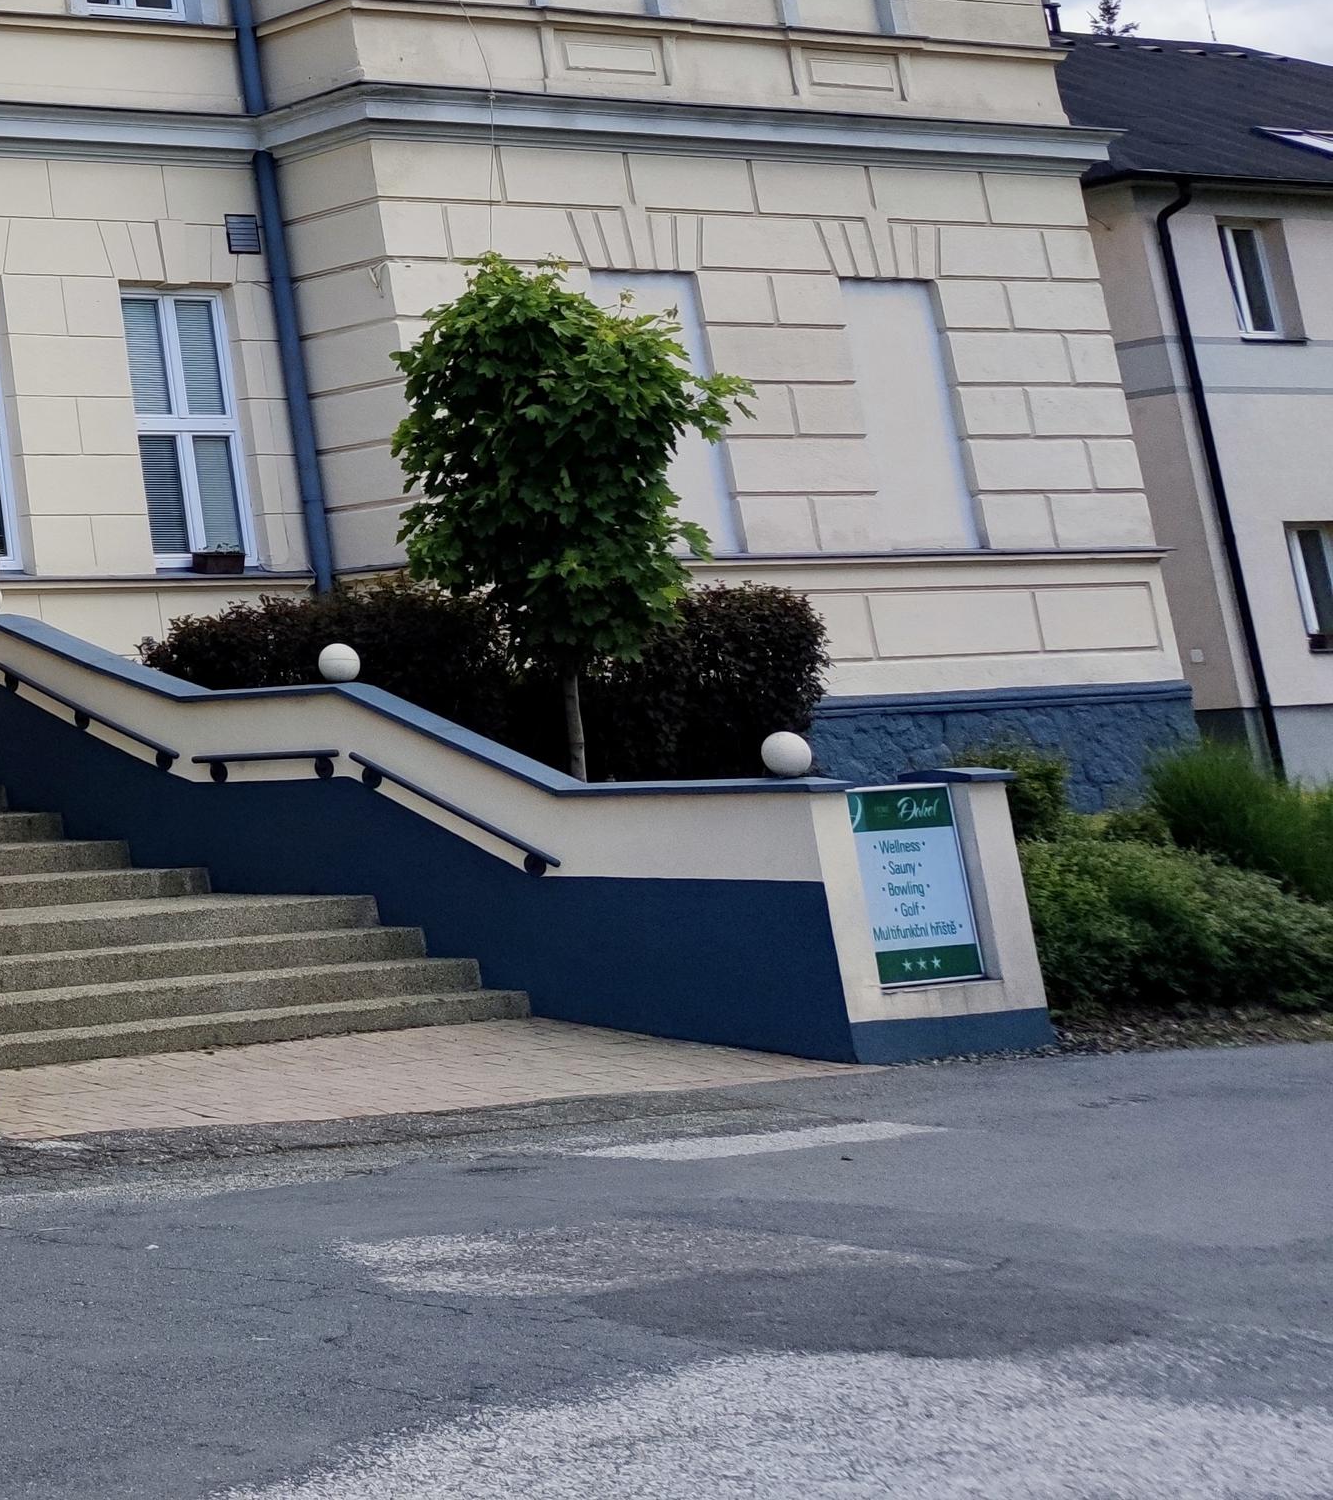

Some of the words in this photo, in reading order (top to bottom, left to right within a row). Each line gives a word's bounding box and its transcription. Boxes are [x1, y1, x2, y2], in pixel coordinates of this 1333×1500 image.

[879, 840, 921, 855] Wellness
[888, 861, 916, 876] Sauny
[887, 882, 925, 897] Bowling
[900, 902, 920, 916] Golf
[873, 924, 929, 941] Multifunkční
[930, 921, 958, 935] hřiště
